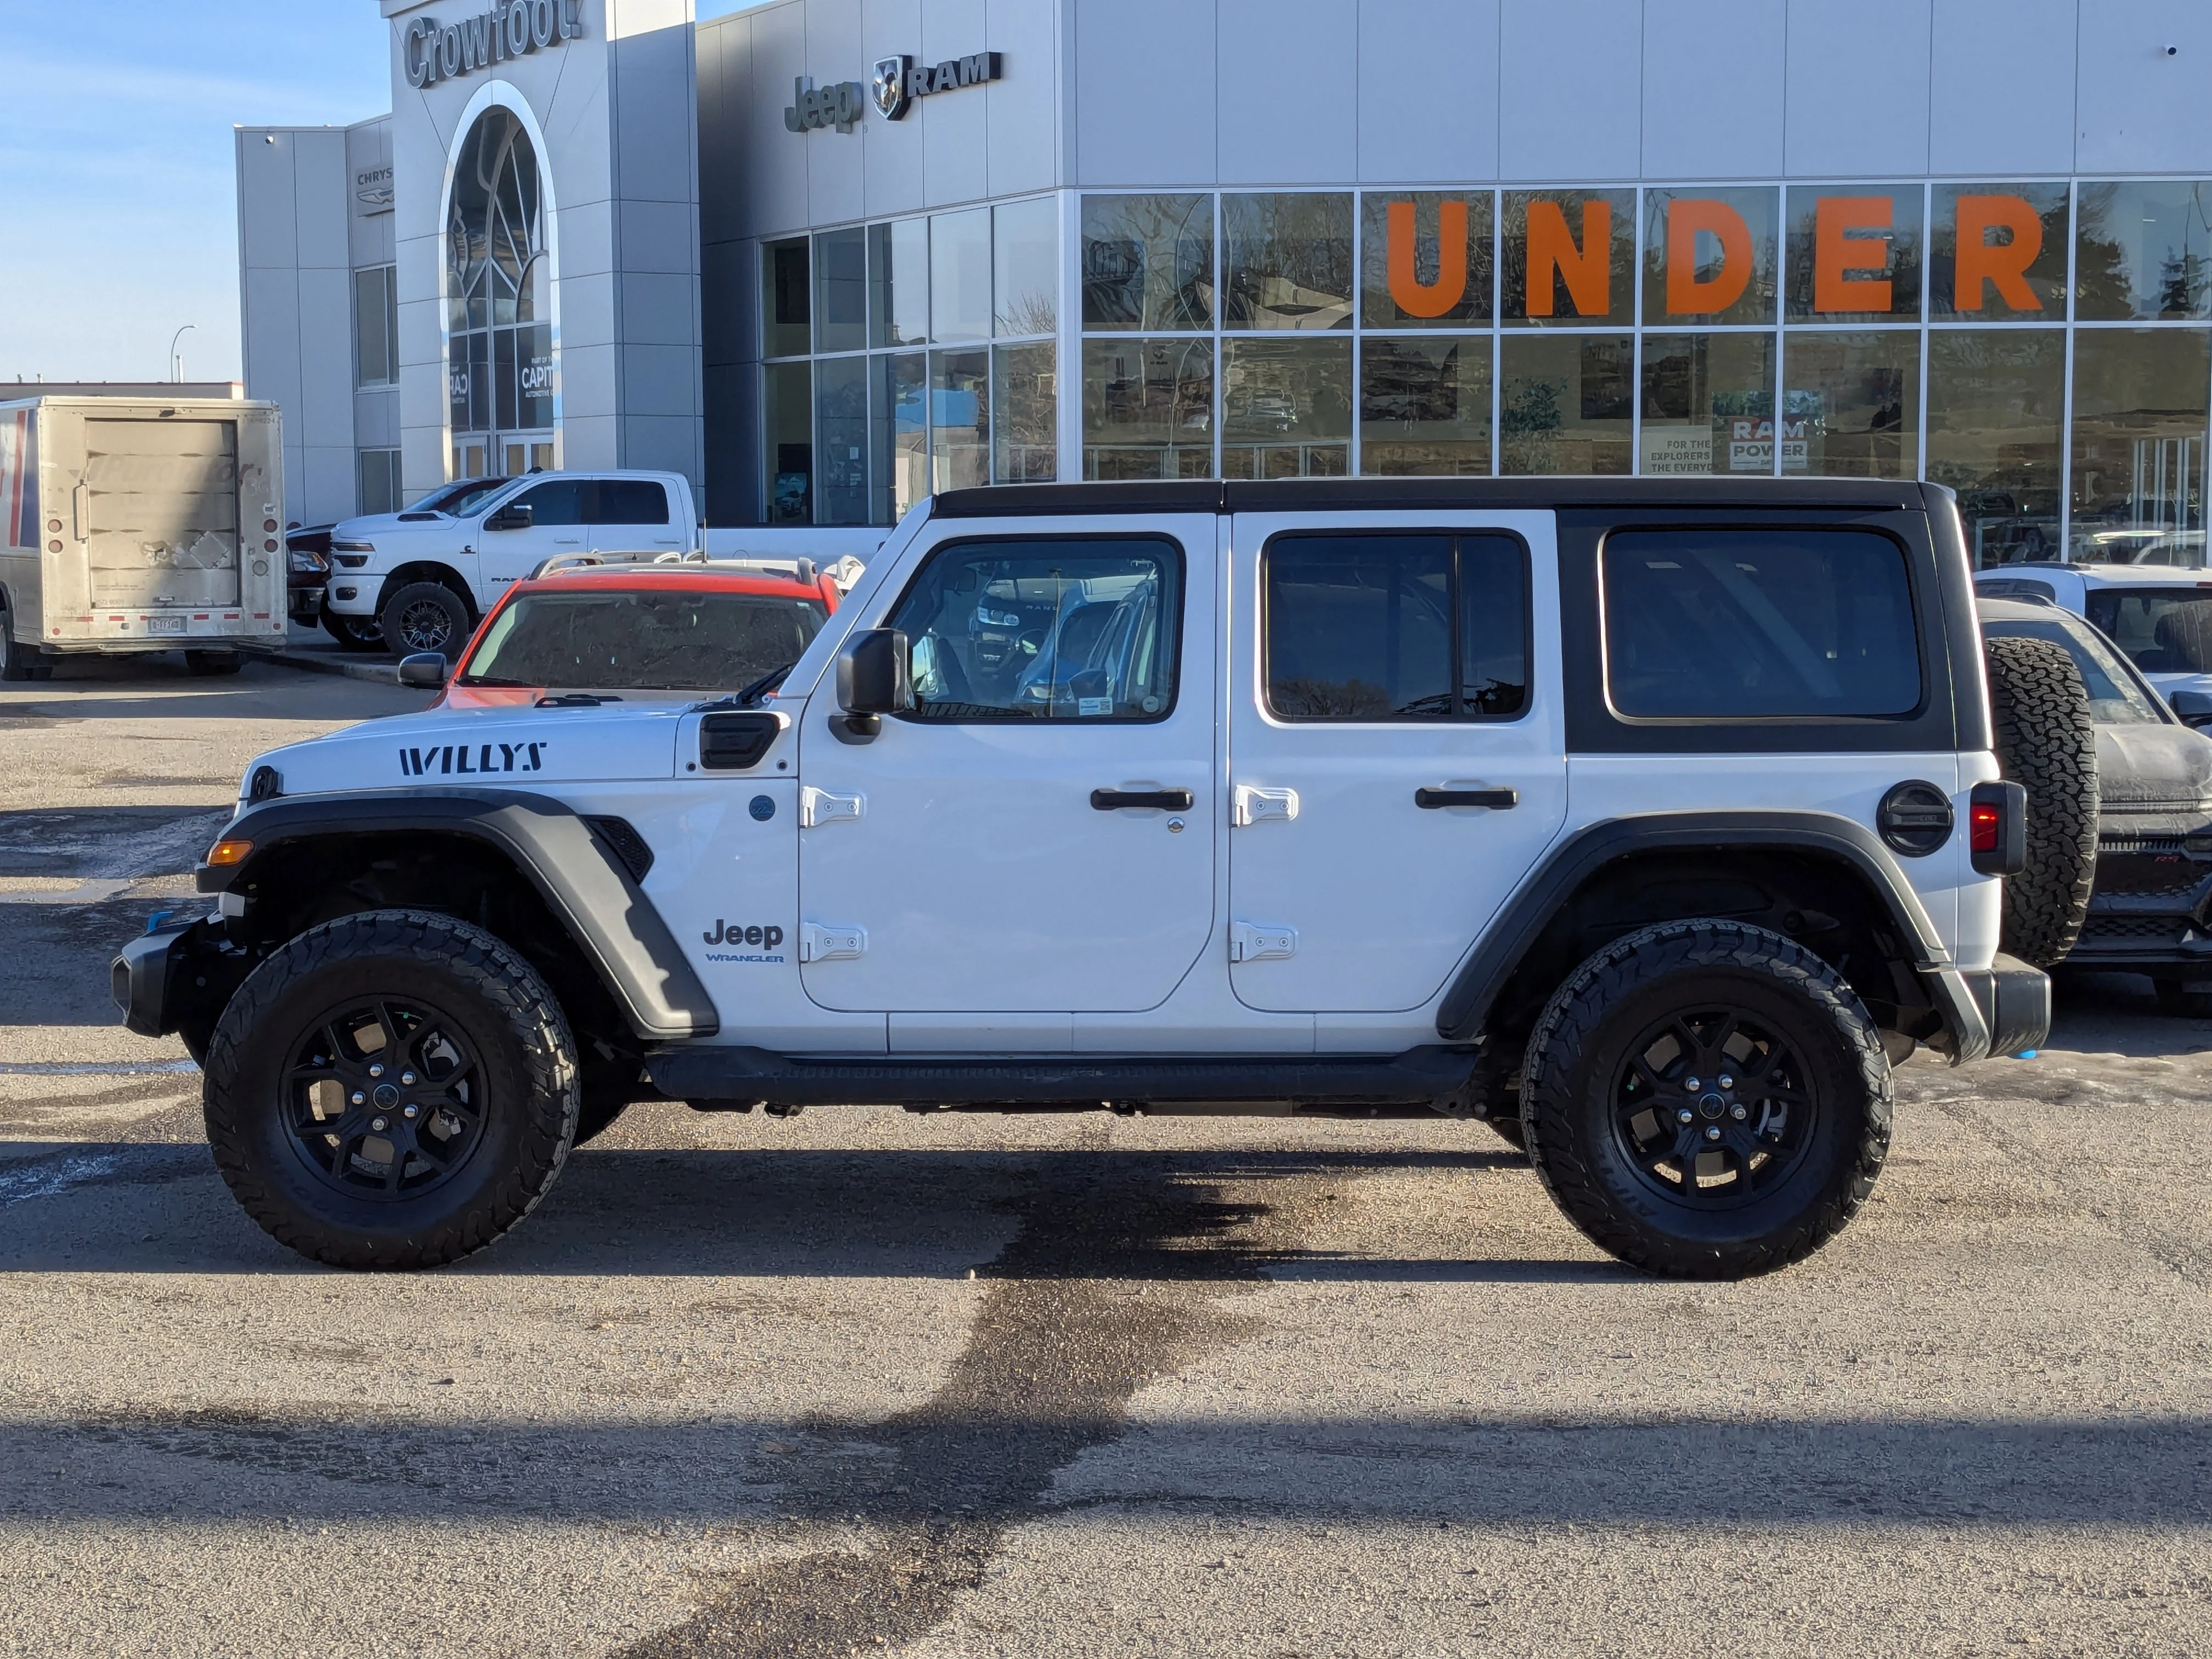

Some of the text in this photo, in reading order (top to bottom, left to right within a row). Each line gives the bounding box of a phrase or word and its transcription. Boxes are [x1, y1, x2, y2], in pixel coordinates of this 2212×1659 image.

[403, 0, 578, 89] Crowfoot
[907, 52, 996, 97] RAM
[785, 76, 860, 134] Jeep
[357, 167, 393, 185] CHRYS
[1387, 194, 2043, 318] UNDER
[1734, 421, 1804, 439] RAM
[1667, 440, 1711, 449] FOR THE
[1734, 444, 1804, 457] POWER
[1651, 452, 1710, 460] EXPLORERS
[1651, 464, 1671, 472] THE
[399, 742, 548, 776] WILLYS
[703, 918, 783, 951] Jeep
[705, 953, 785, 963] WRANGLER
